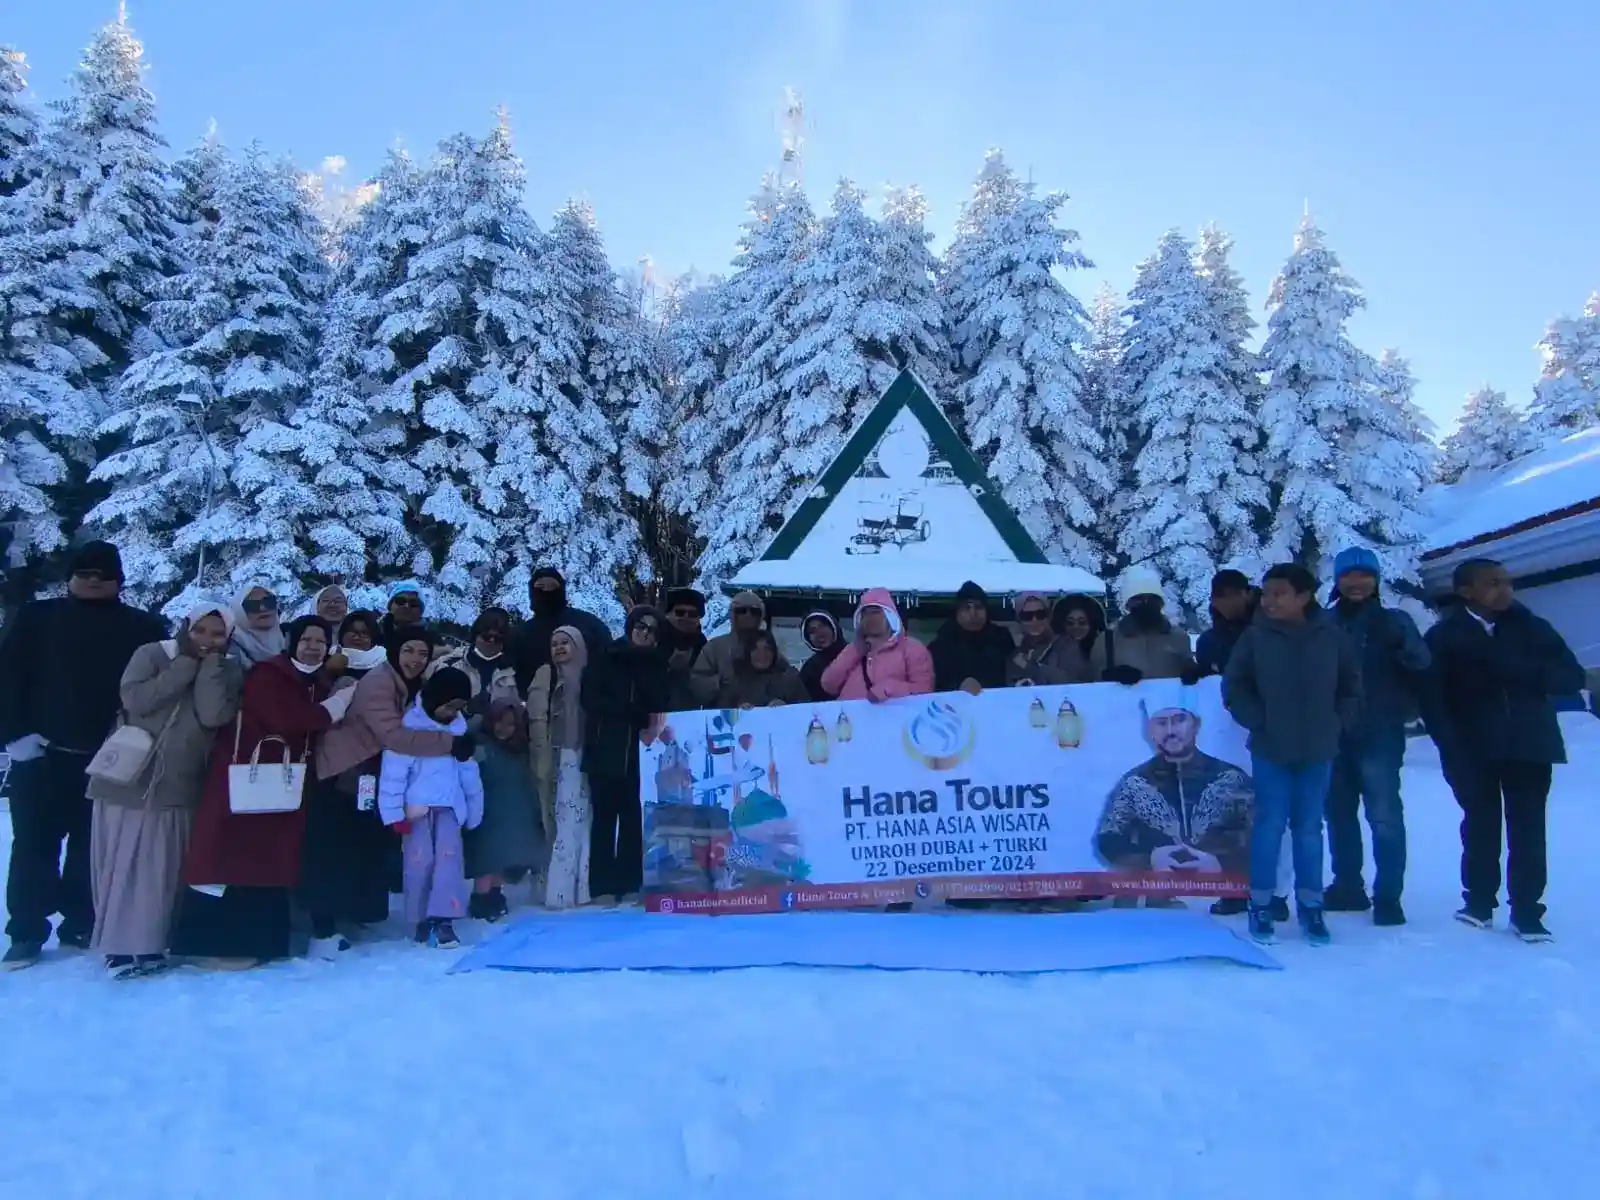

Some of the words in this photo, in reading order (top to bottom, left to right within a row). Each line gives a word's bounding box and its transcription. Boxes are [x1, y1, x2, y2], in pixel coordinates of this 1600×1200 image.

[842, 785, 938, 818] Hana
[945, 778, 1050, 811] Tours
[845, 822, 871, 841] PT.
[876, 817, 929, 839] HANA
[935, 815, 976, 835] ASIA
[982, 812, 1051, 833] WISATA
[851, 842, 916, 860] UMROH
[921, 839, 974, 857] DUBAI
[979, 842, 990, 852] +
[993, 837, 1047, 853] TURKI
[865, 861, 889, 878] 22
[894, 856, 986, 876] Desember
[990, 854, 1036, 871] 2024
[827, 890, 859, 901] Tours
